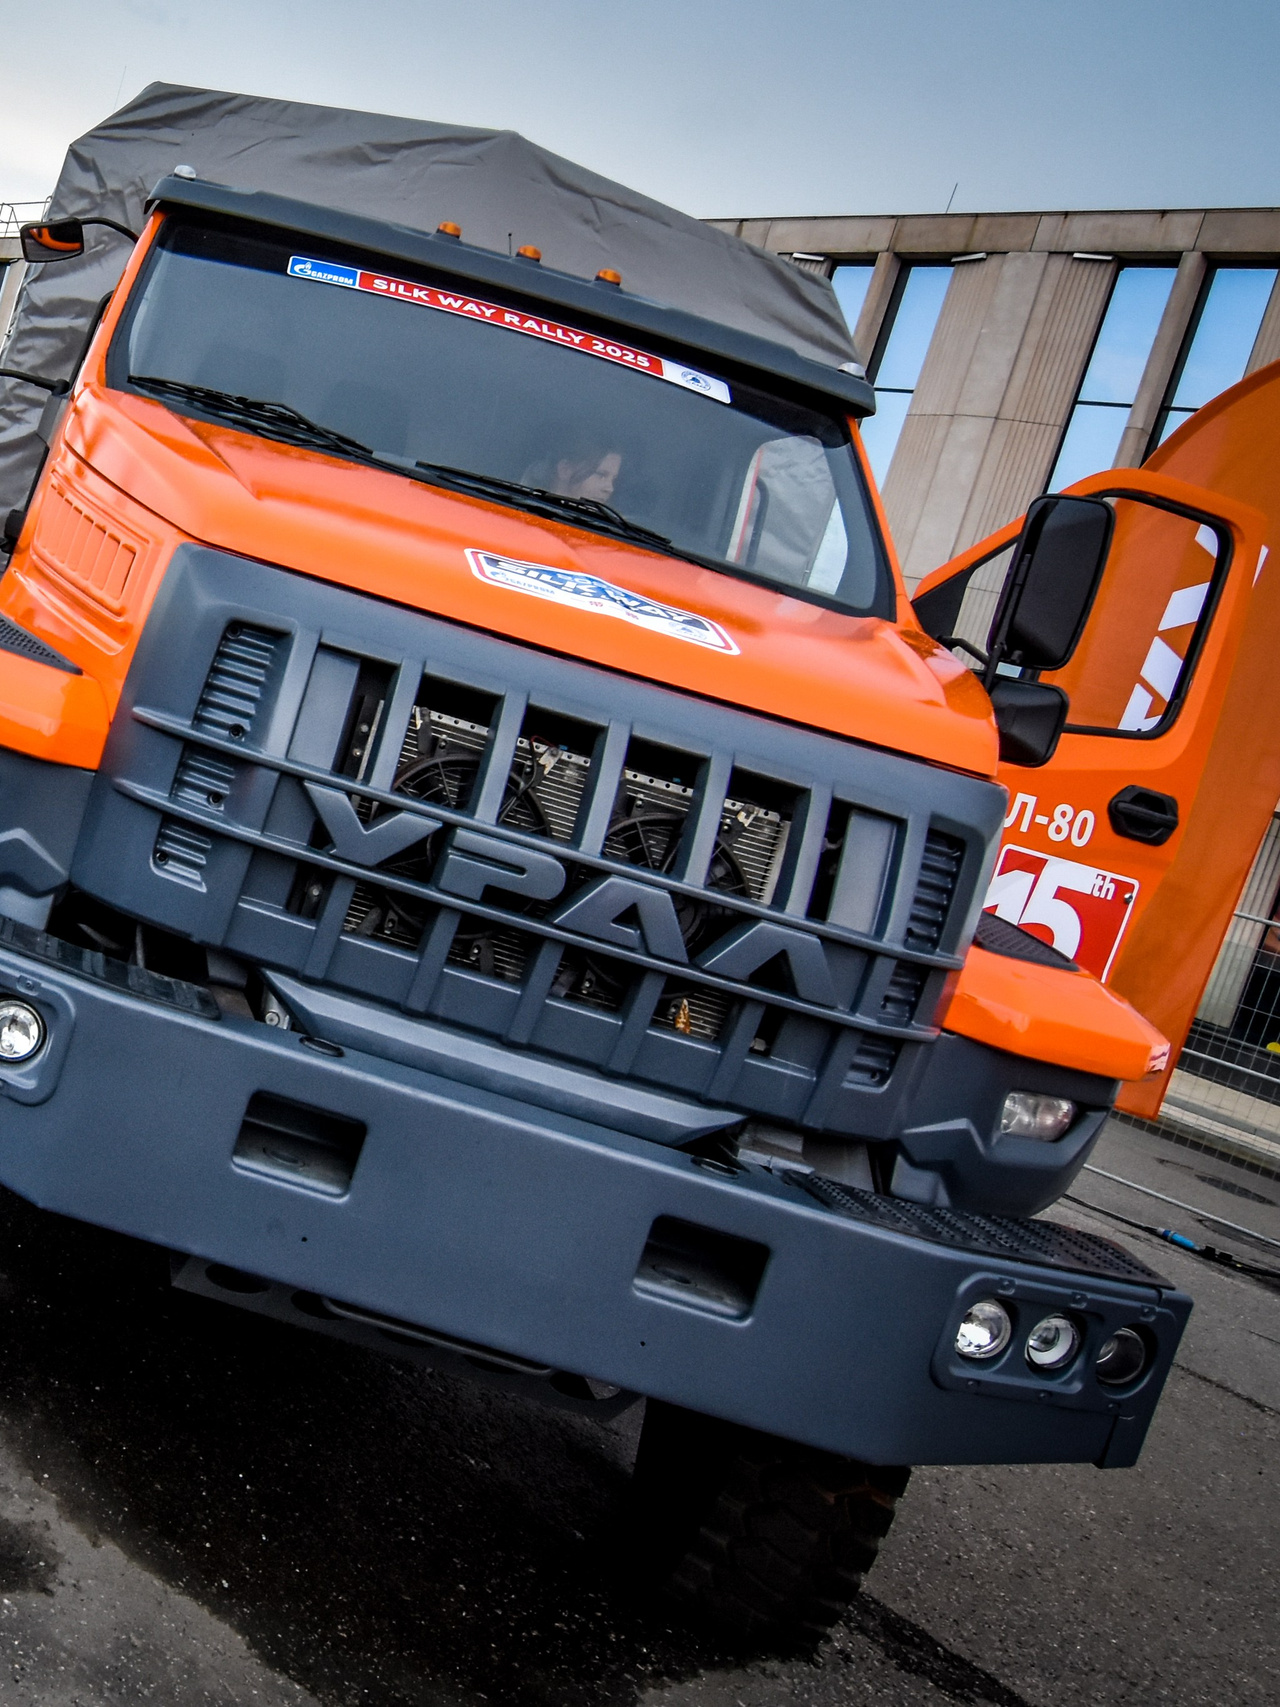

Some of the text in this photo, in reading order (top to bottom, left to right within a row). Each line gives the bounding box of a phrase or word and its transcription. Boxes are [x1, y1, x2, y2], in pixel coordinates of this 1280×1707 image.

[311, 271, 354, 286] GAZPROM
[372, 278, 651, 368] SILK WAY RALLY 2025
[496, 560, 598, 597] SILK
[603, 588, 696, 623] WAY
[1003, 792, 1096, 848] Л-80
